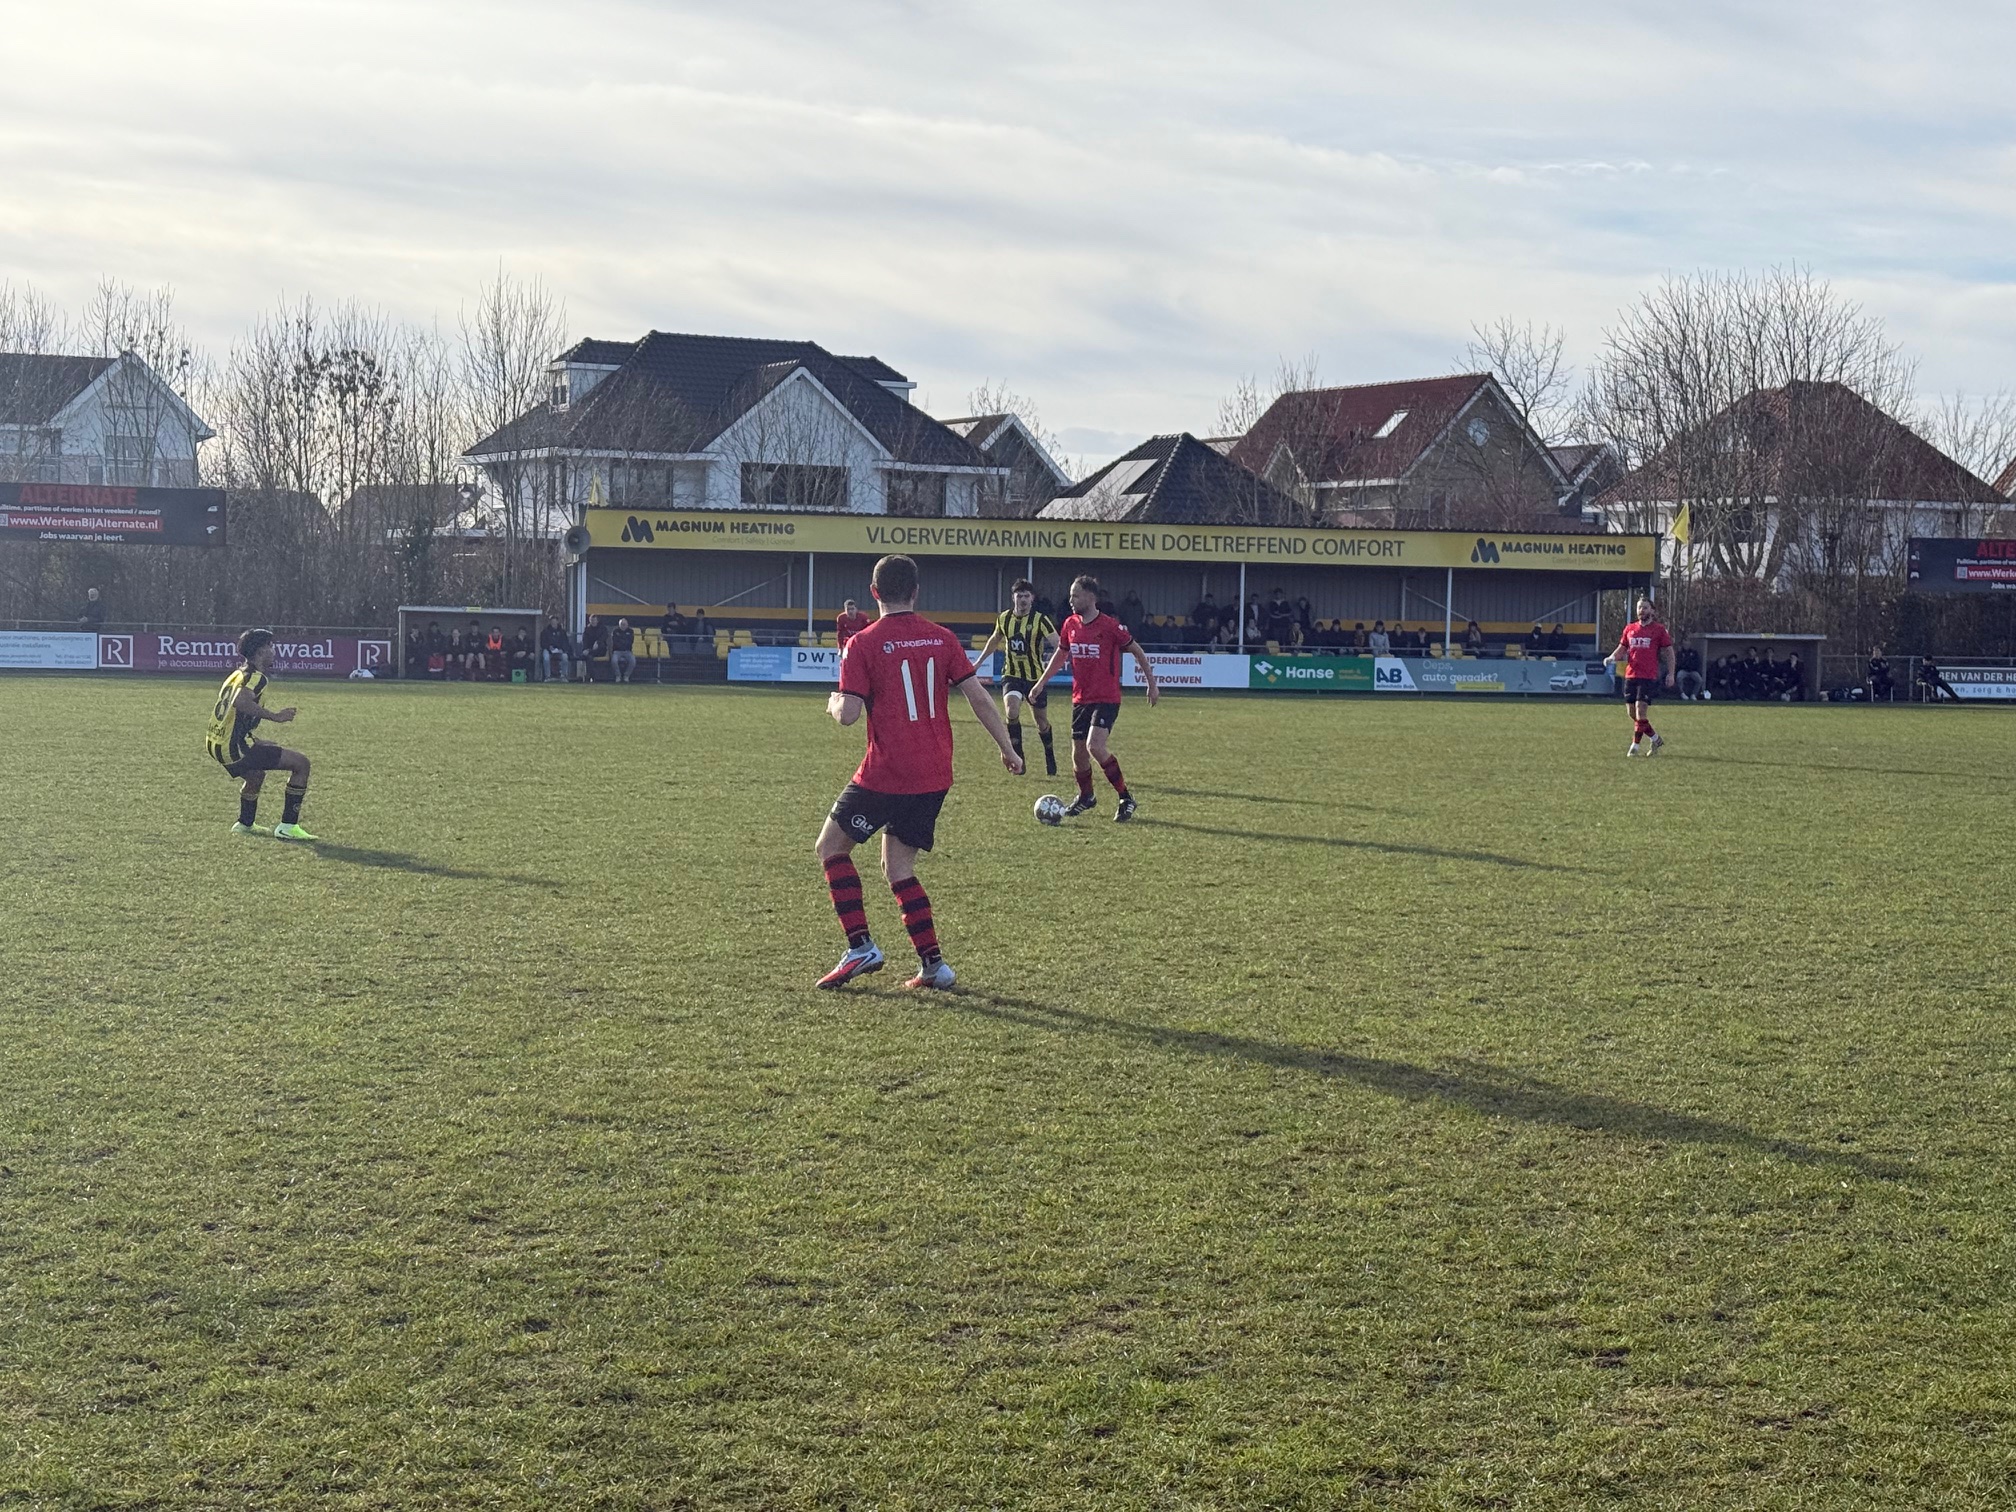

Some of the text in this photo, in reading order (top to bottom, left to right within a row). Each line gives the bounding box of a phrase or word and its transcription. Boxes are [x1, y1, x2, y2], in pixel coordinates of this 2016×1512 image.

[19, 485, 137, 506] ALTERNATE
[10, 516, 158, 530] www.WerkenBijAlternate.nl
[656, 520, 725, 533] MAGNUM
[730, 522, 796, 535] HEATING
[39, 531, 125, 542] Jobs waarvan je leert.
[866, 526, 1405, 557] VLOERVERWARMING MET EEN DOELTREFFEND COMFORT
[1502, 541, 1564, 555] MAGNUM
[1568, 543, 1626, 556] HEATING
[158, 635, 334, 659] Remmwaal
[1070, 642, 1100, 655] BTS
[158, 659, 168, 669] je
[170, 660, 223, 669] accountant
[225, 660, 233, 668] &
[292, 660, 333, 670] adviseur
[1135, 666, 1154, 674] MT
[1422, 661, 1453, 671] Oeps,
[1286, 666, 1334, 679] Hanse
[1376, 667, 1402, 683] AB
[1422, 673, 1498, 684] auto geraakt?
[1960, 672, 1981, 681] VAN
[1983, 672, 2003, 682] DER
[1135, 675, 1202, 684] VETROUWEN
[901, 656, 935, 722] 11
[1973, 687, 1992, 695] zorg
